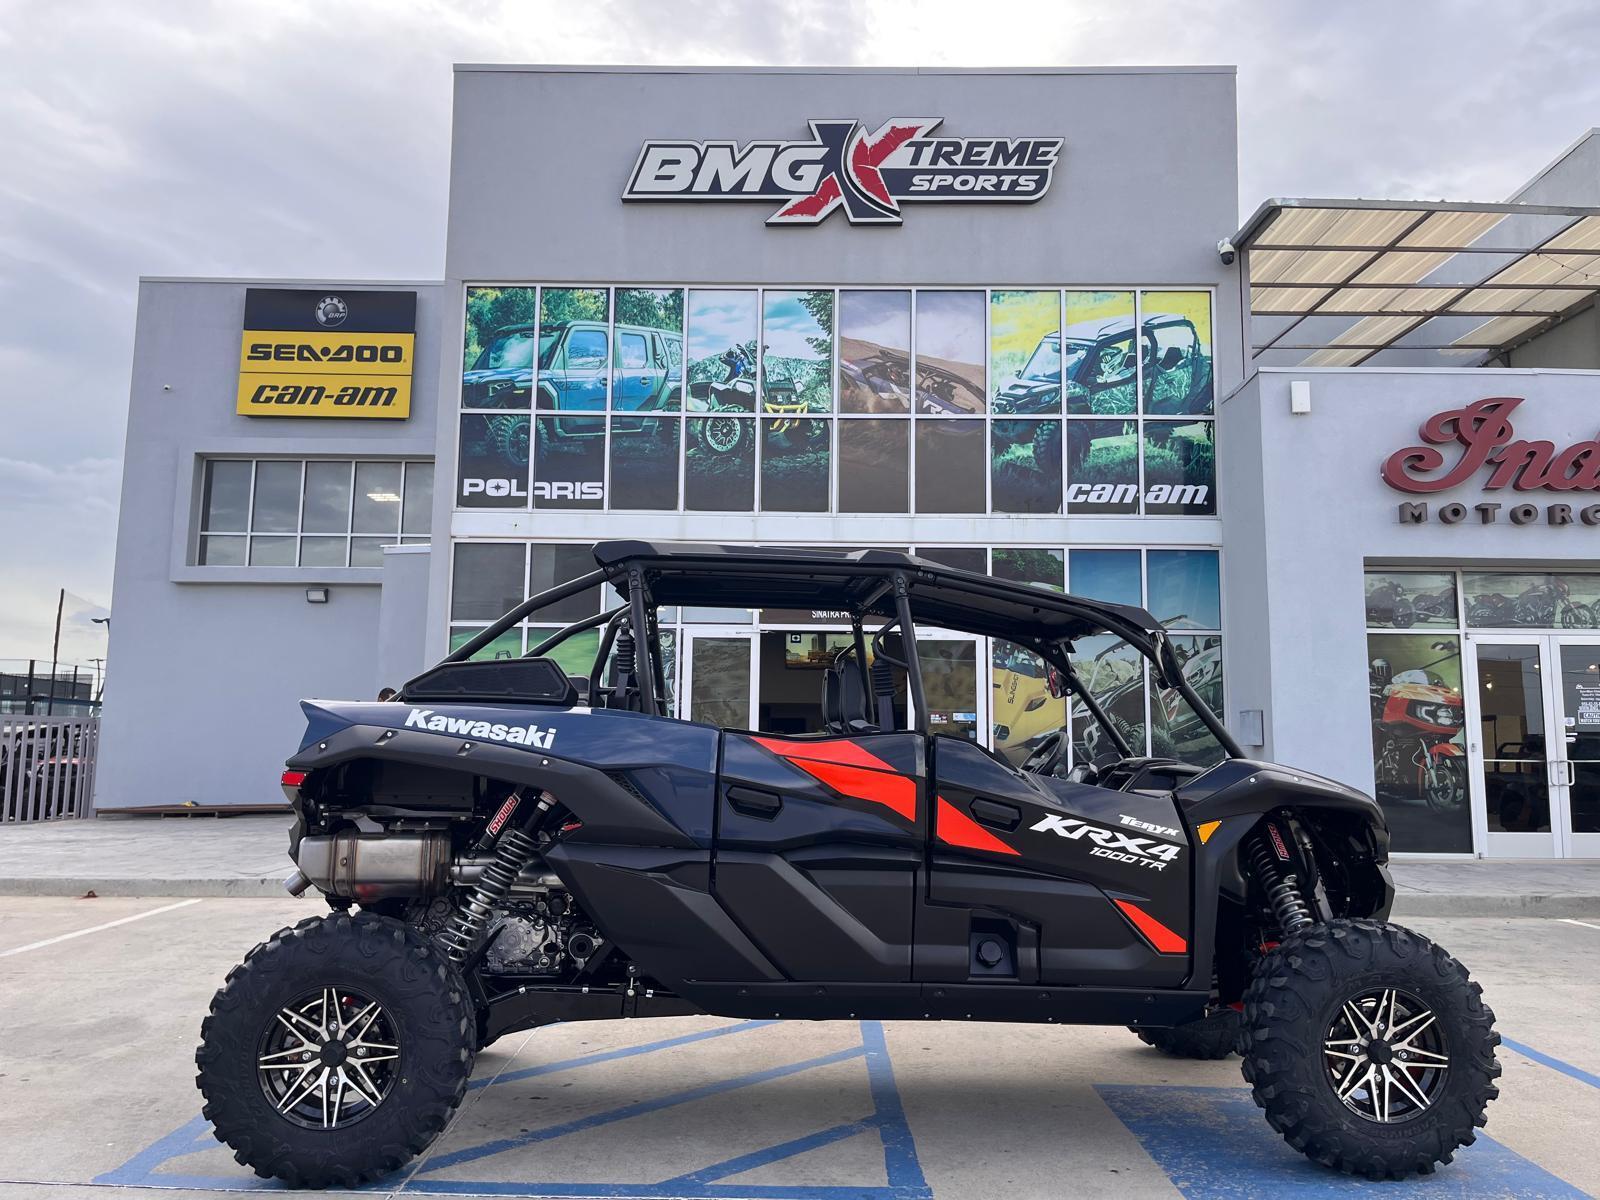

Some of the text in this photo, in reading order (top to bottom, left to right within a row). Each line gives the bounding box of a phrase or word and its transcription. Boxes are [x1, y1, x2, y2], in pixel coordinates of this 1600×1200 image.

[632, 146, 831, 192] BMG
[908, 174, 1041, 192] SPORTS
[250, 384, 398, 407] can-am
[462, 478, 604, 500] POLARIS
[404, 708, 557, 749] Kawasaki
[489, 796, 518, 835] SHOWA
[1029, 812, 1182, 862] KRX4
